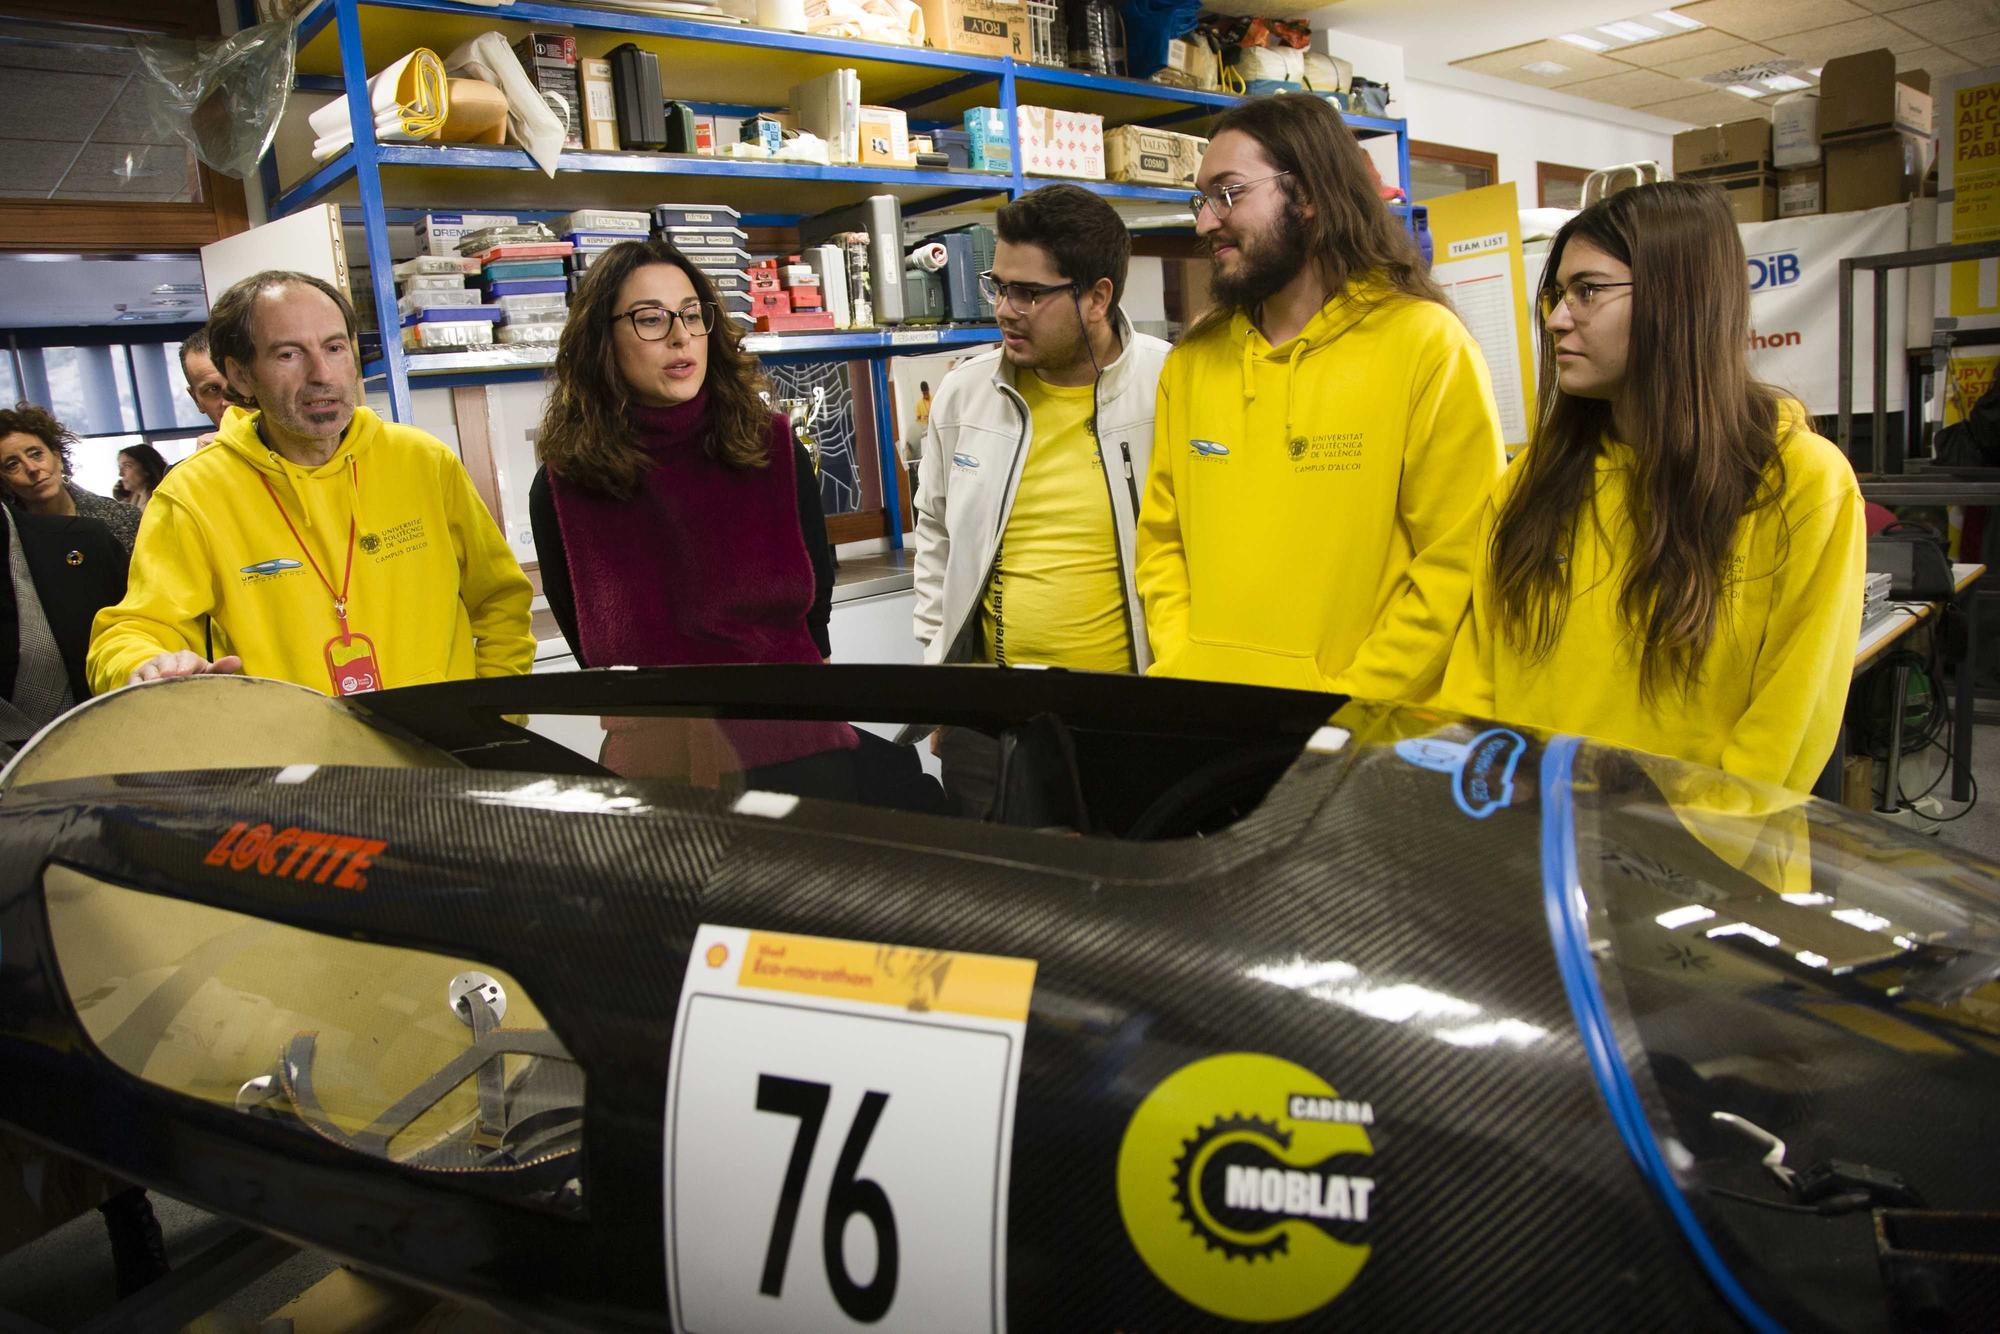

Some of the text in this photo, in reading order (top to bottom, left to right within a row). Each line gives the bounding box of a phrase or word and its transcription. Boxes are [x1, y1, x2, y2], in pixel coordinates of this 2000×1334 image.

[971, 19, 1000, 35] ROLY
[1959, 104, 2000, 127] ALC
[1959, 125, 1984, 144] DE
[1958, 140, 2000, 161] FAB
[1143, 158, 1166, 170] COSMO
[1453, 237, 1503, 253] TEAM LIST
[1746, 330, 1802, 350] hon
[1312, 433, 1364, 442] UNIVERSITAT
[1310, 451, 1320, 459] DE
[1294, 464, 1326, 474] CAMPUS
[203, 821, 387, 890] LOCTITE
[1289, 1095, 1375, 1124] CADENA
[755, 1072, 899, 1324] 76
[1224, 1164, 1376, 1222] MOBLAT
